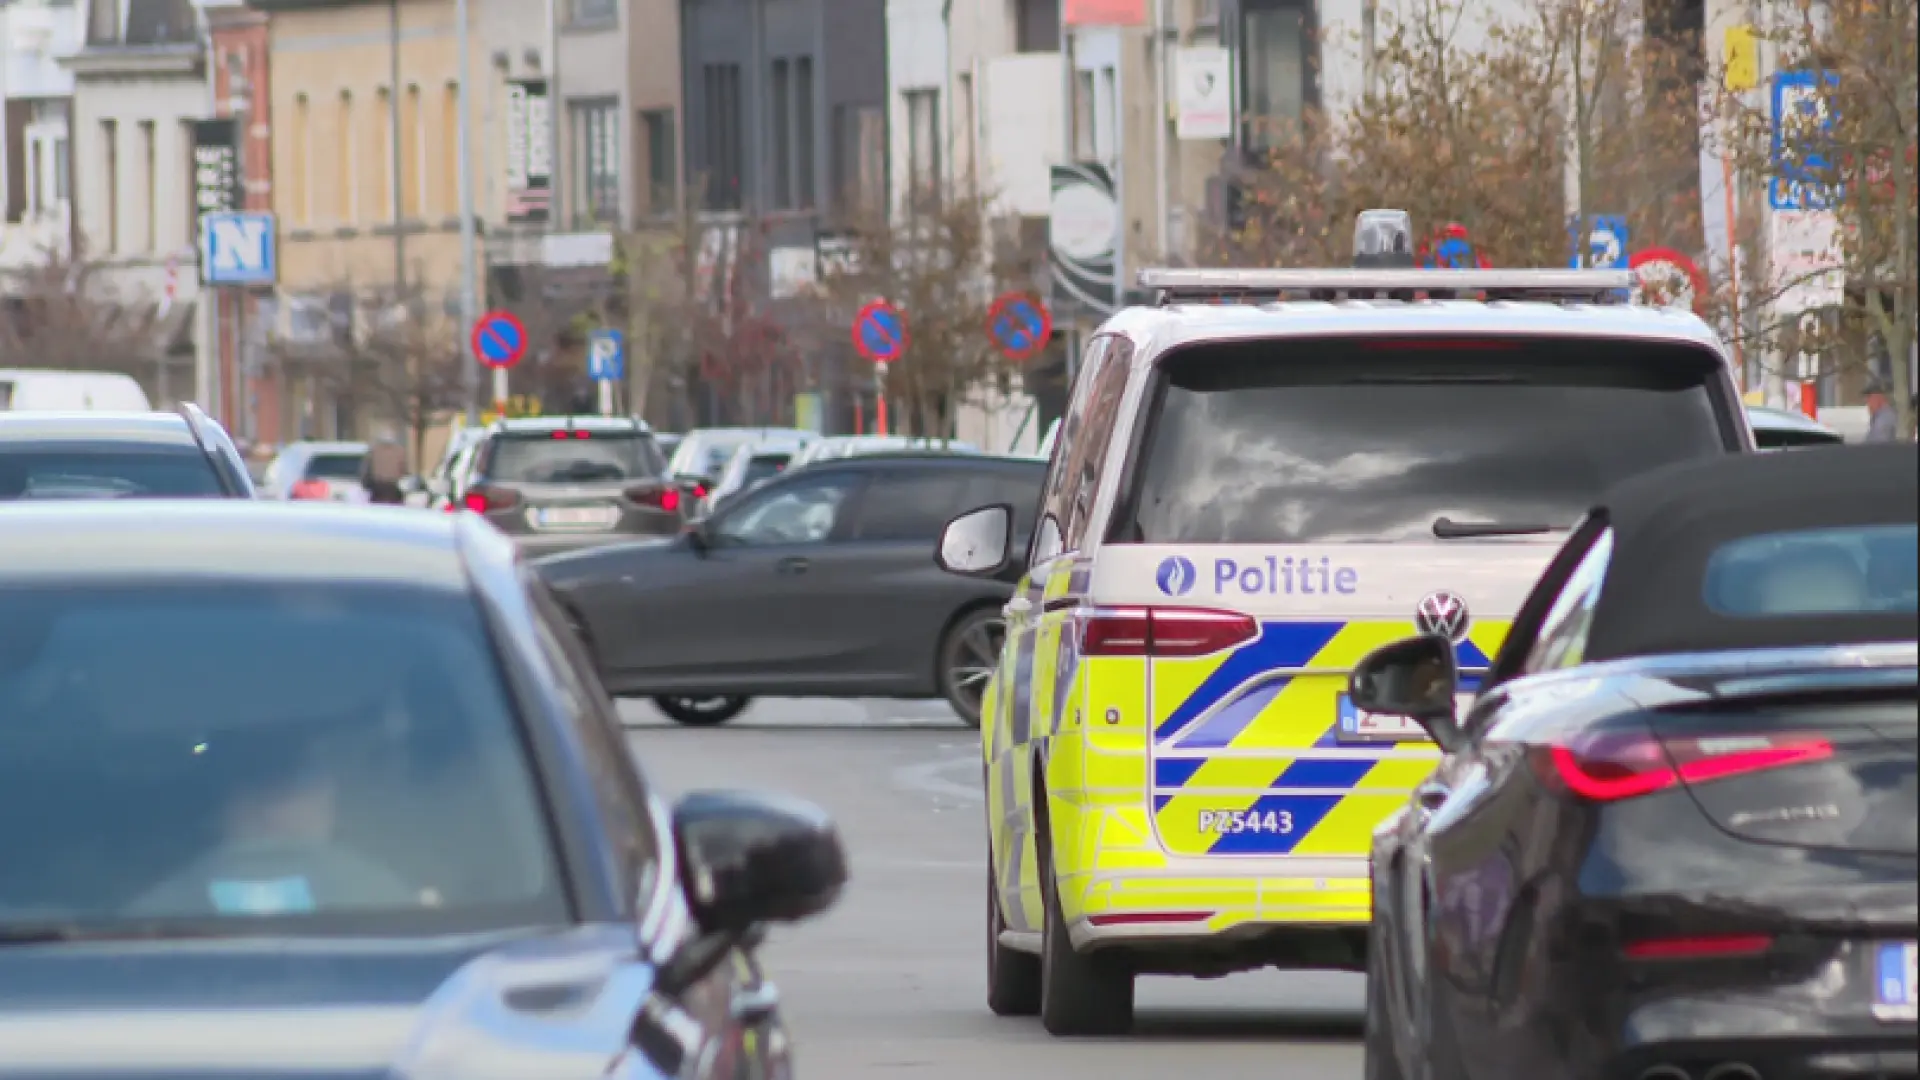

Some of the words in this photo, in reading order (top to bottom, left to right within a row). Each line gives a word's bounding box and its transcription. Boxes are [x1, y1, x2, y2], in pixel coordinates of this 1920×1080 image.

[213, 220, 266, 269] N
[592, 337, 616, 374] P
[1214, 555, 1359, 594] Politie
[1198, 809, 1294, 833] PZ5443
